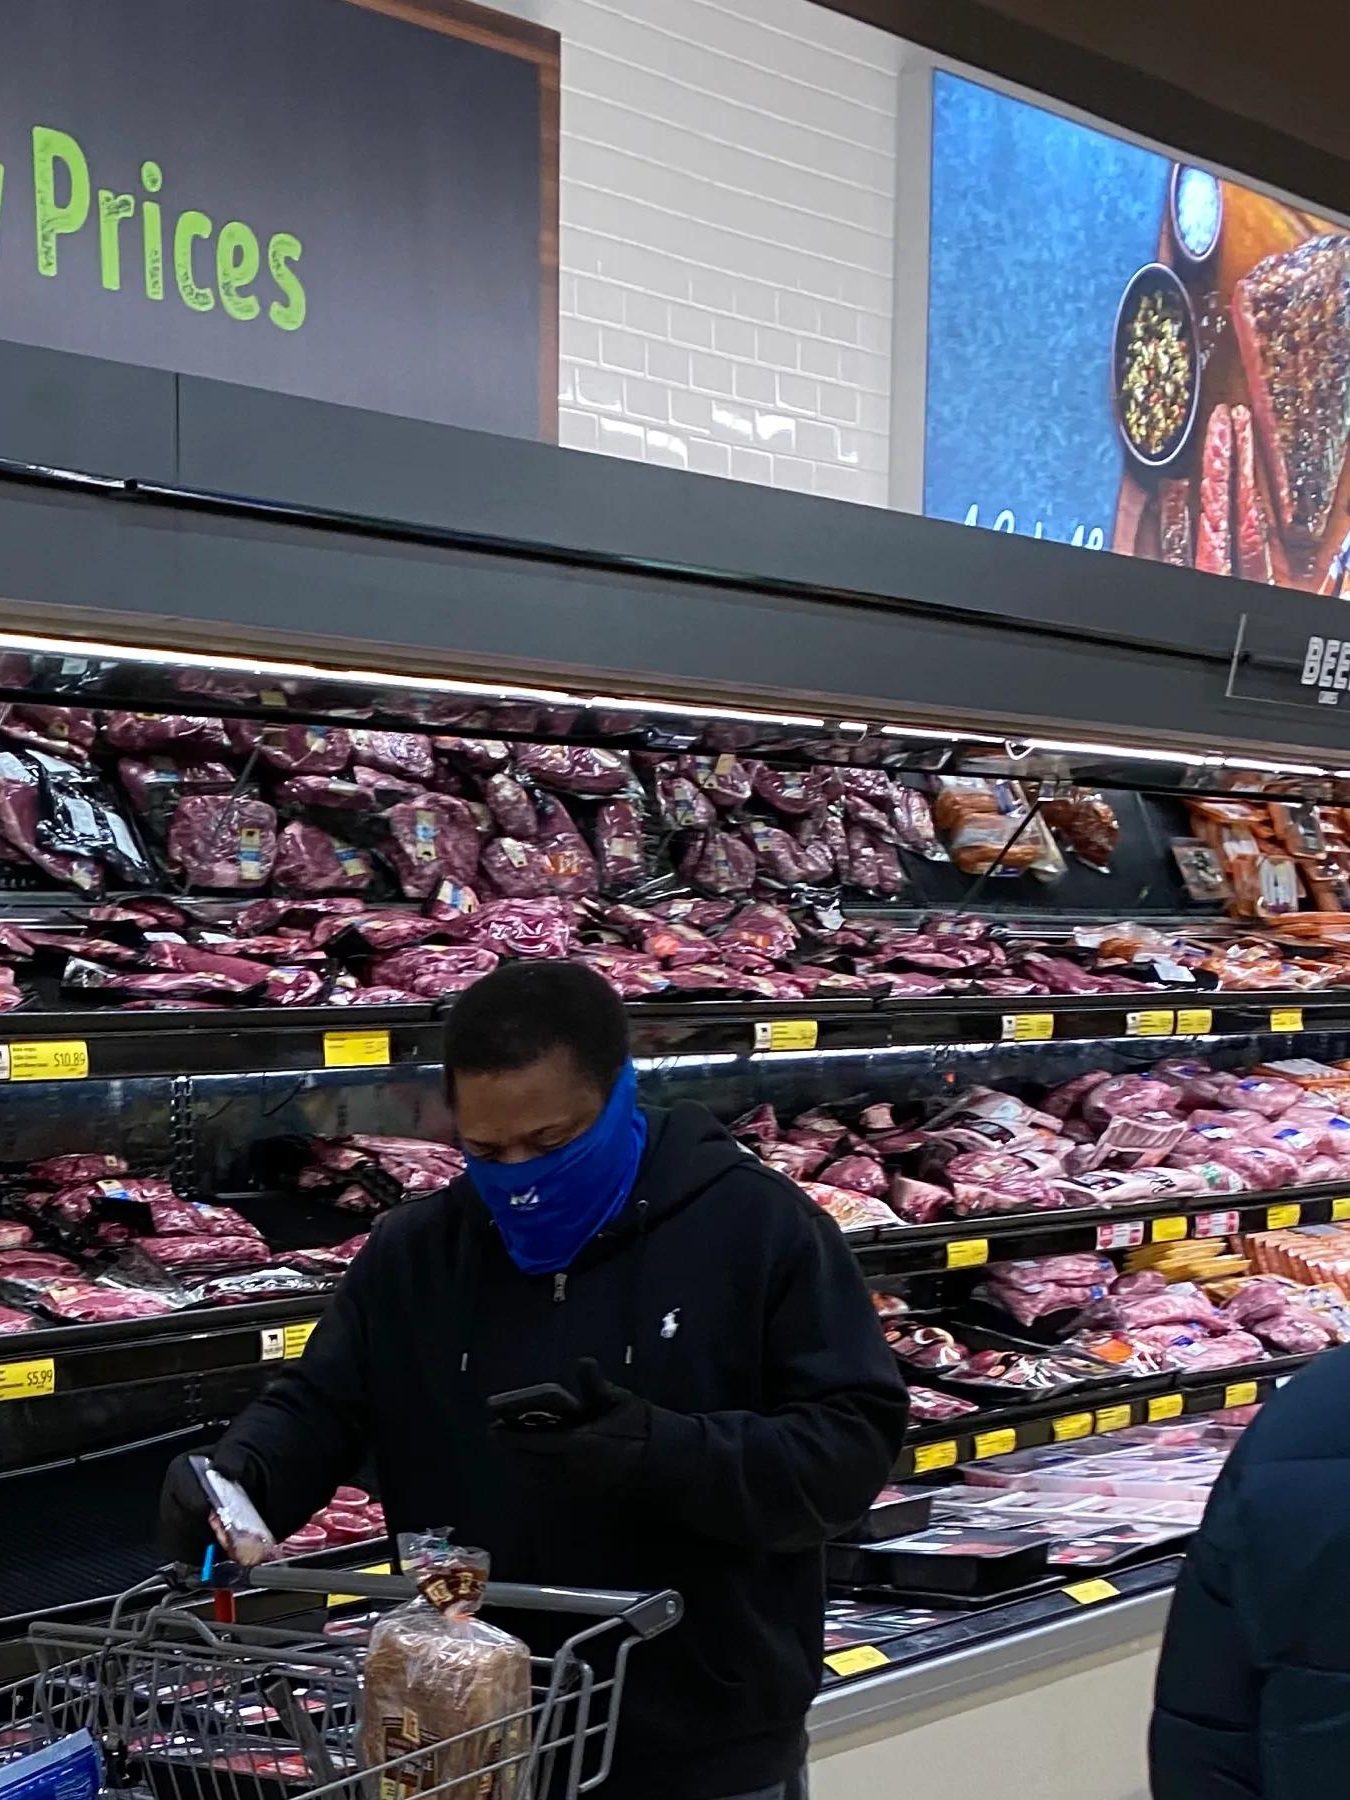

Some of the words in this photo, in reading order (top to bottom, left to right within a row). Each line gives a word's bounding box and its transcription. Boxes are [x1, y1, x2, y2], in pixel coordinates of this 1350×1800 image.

[32, 126, 307, 331] Prices
[1301, 635, 1350, 690] BEE
[26, 1369, 53, 1386] $5.99
